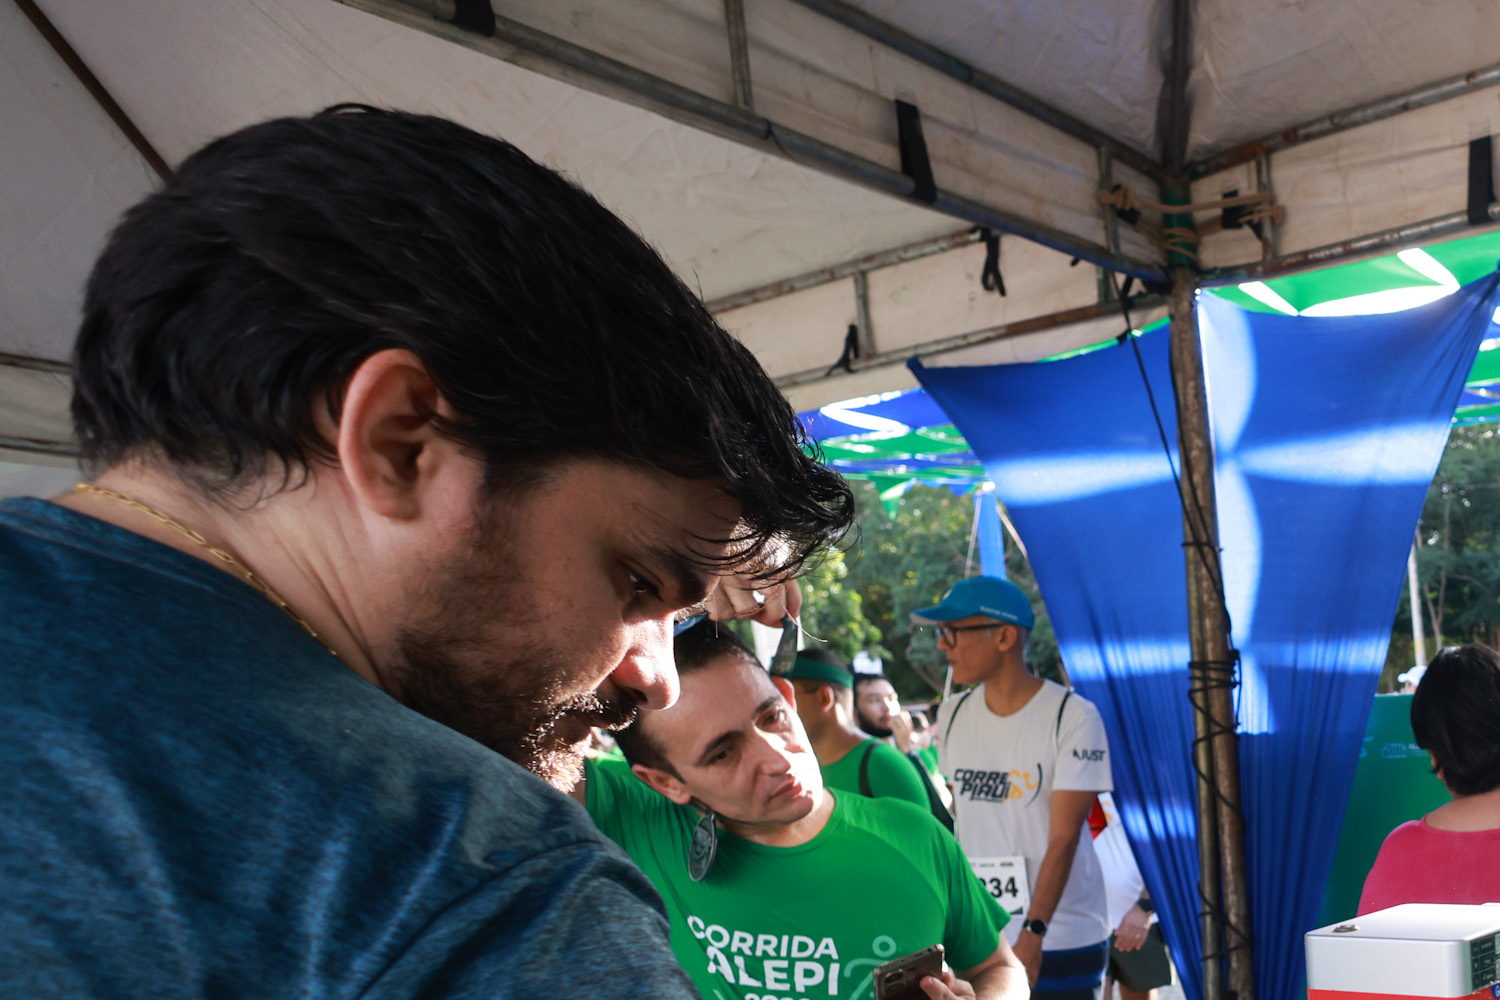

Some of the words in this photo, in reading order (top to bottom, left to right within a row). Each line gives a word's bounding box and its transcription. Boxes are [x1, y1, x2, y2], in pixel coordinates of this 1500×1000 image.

[954, 769, 1009, 785] CORRE
[980, 877, 1018, 898] 34
[687, 915, 840, 960] CORRIDA
[706, 945, 840, 995] ALEPI
